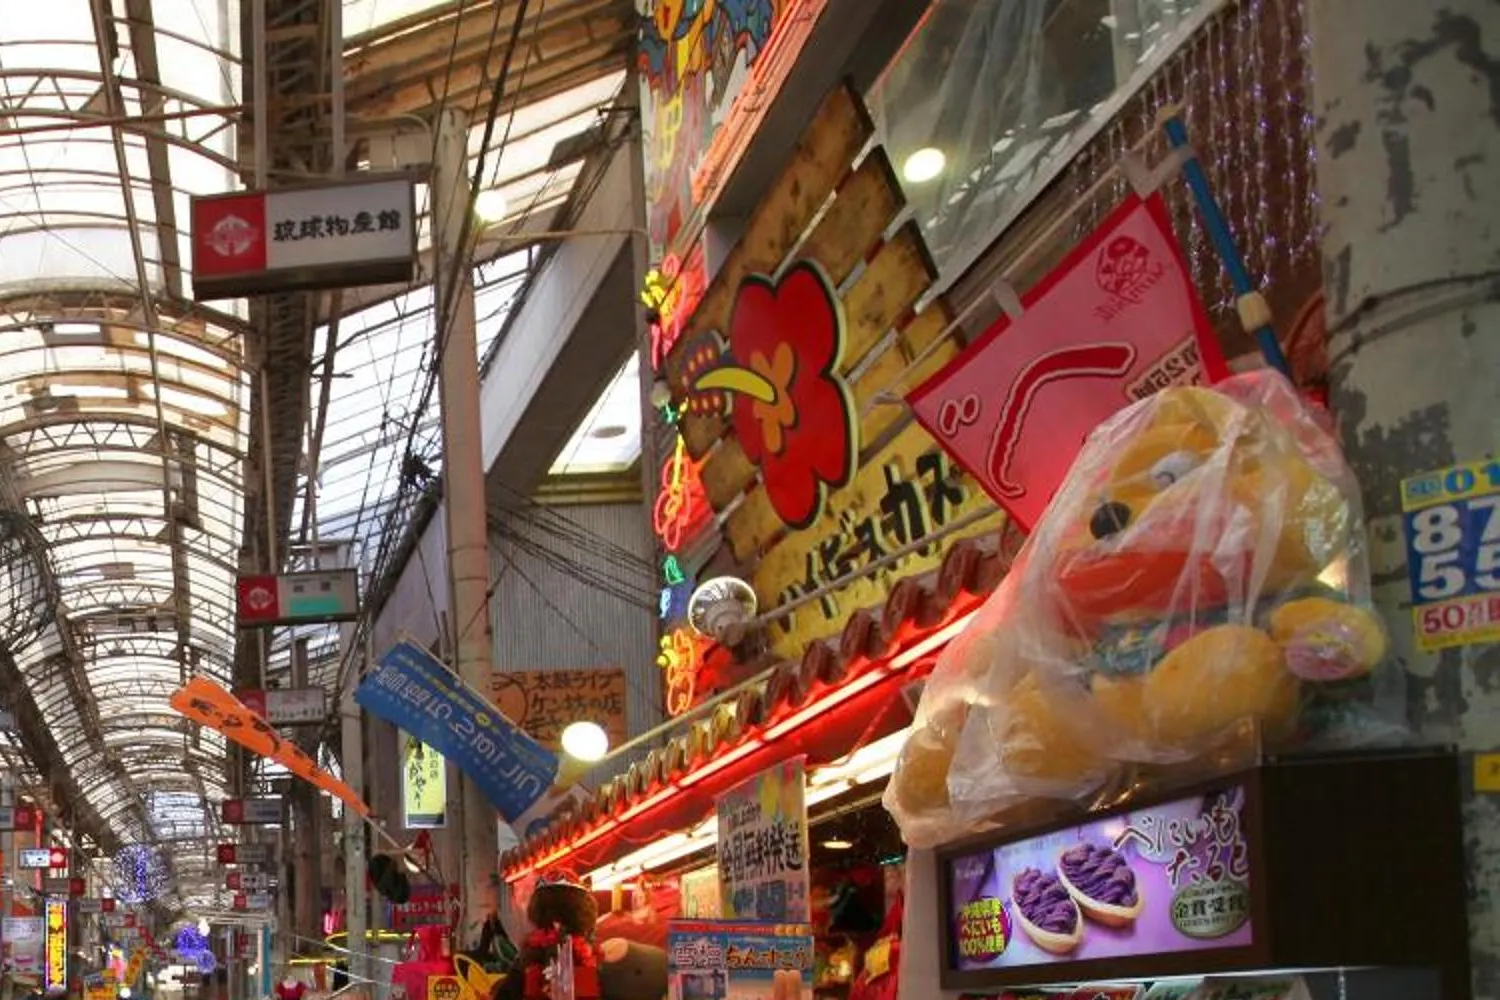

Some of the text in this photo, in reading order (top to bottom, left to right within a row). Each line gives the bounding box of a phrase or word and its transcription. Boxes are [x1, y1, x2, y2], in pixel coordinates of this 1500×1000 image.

[273, 209, 402, 241] 琉球物産館
